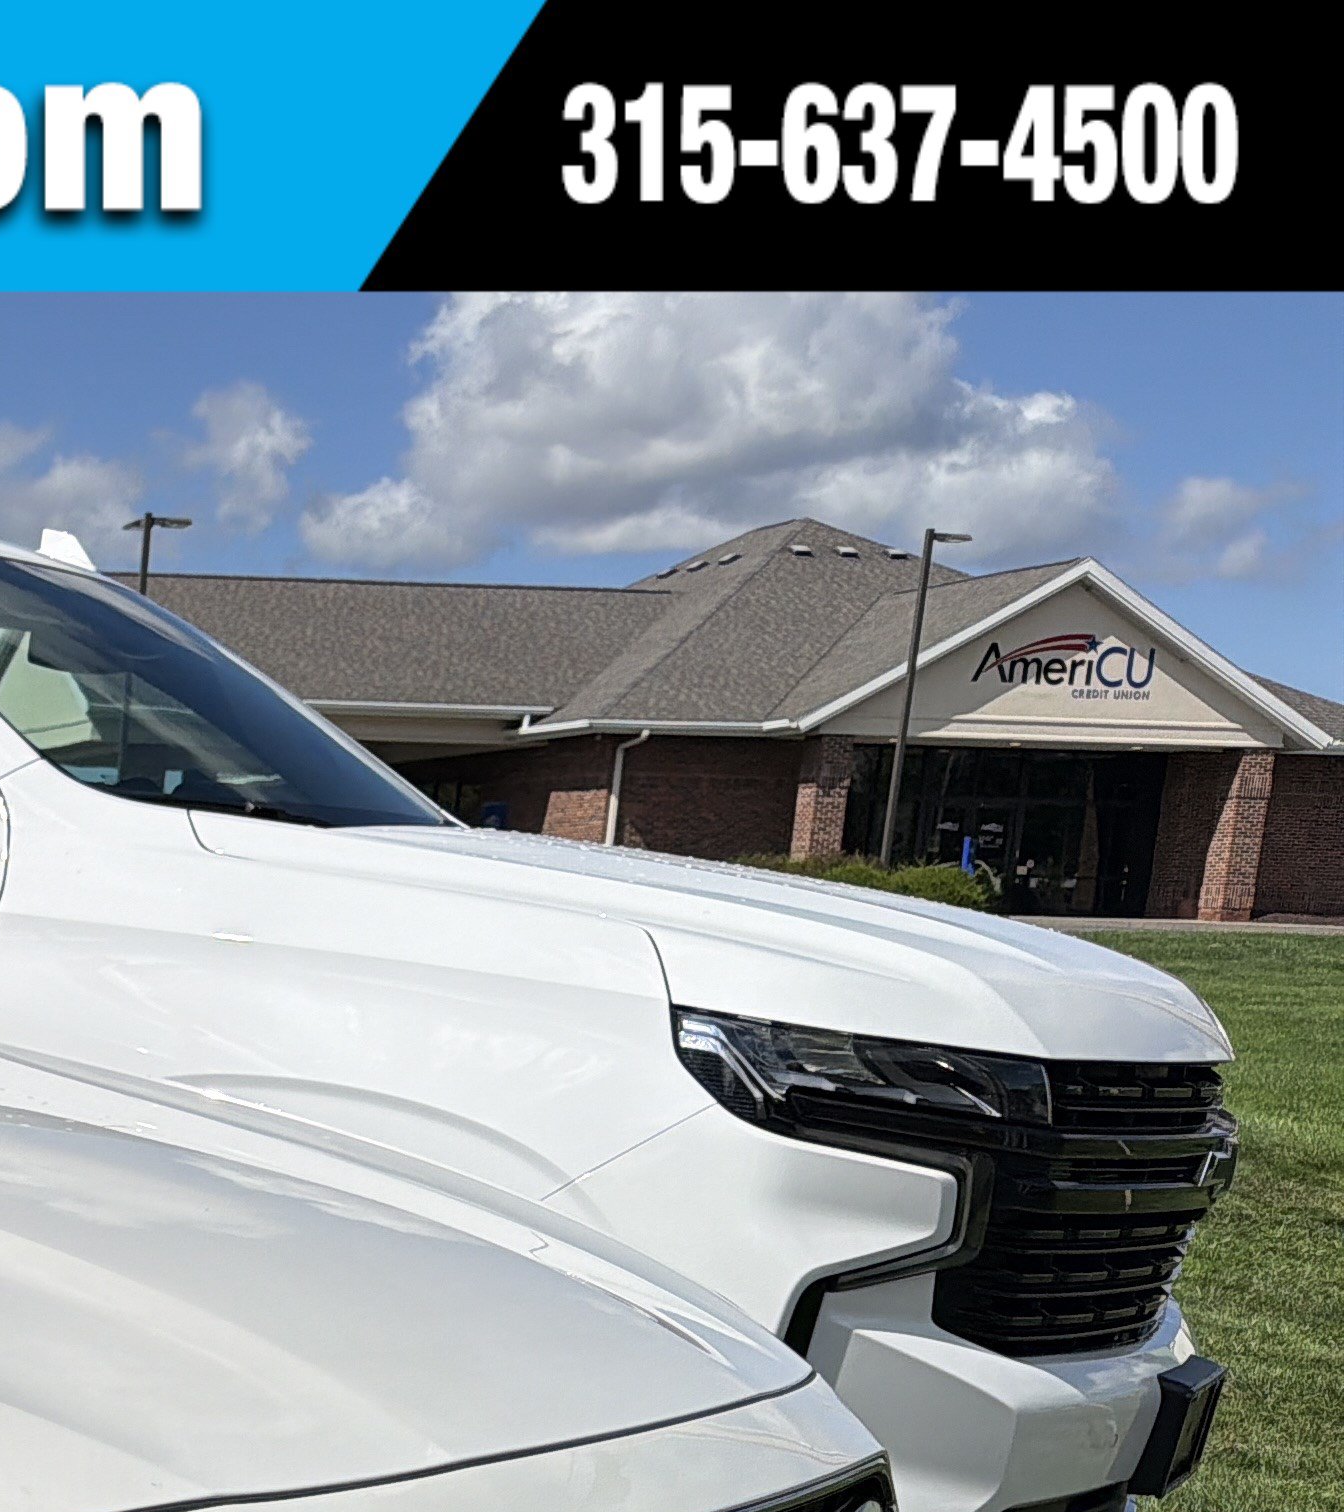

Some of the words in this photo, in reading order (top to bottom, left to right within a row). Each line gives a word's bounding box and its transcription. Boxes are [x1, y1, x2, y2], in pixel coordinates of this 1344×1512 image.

[970, 641, 1156, 689] AmeriCU
[1071, 688, 1109, 700] CREDIT
[1113, 689, 1151, 701] UNION
